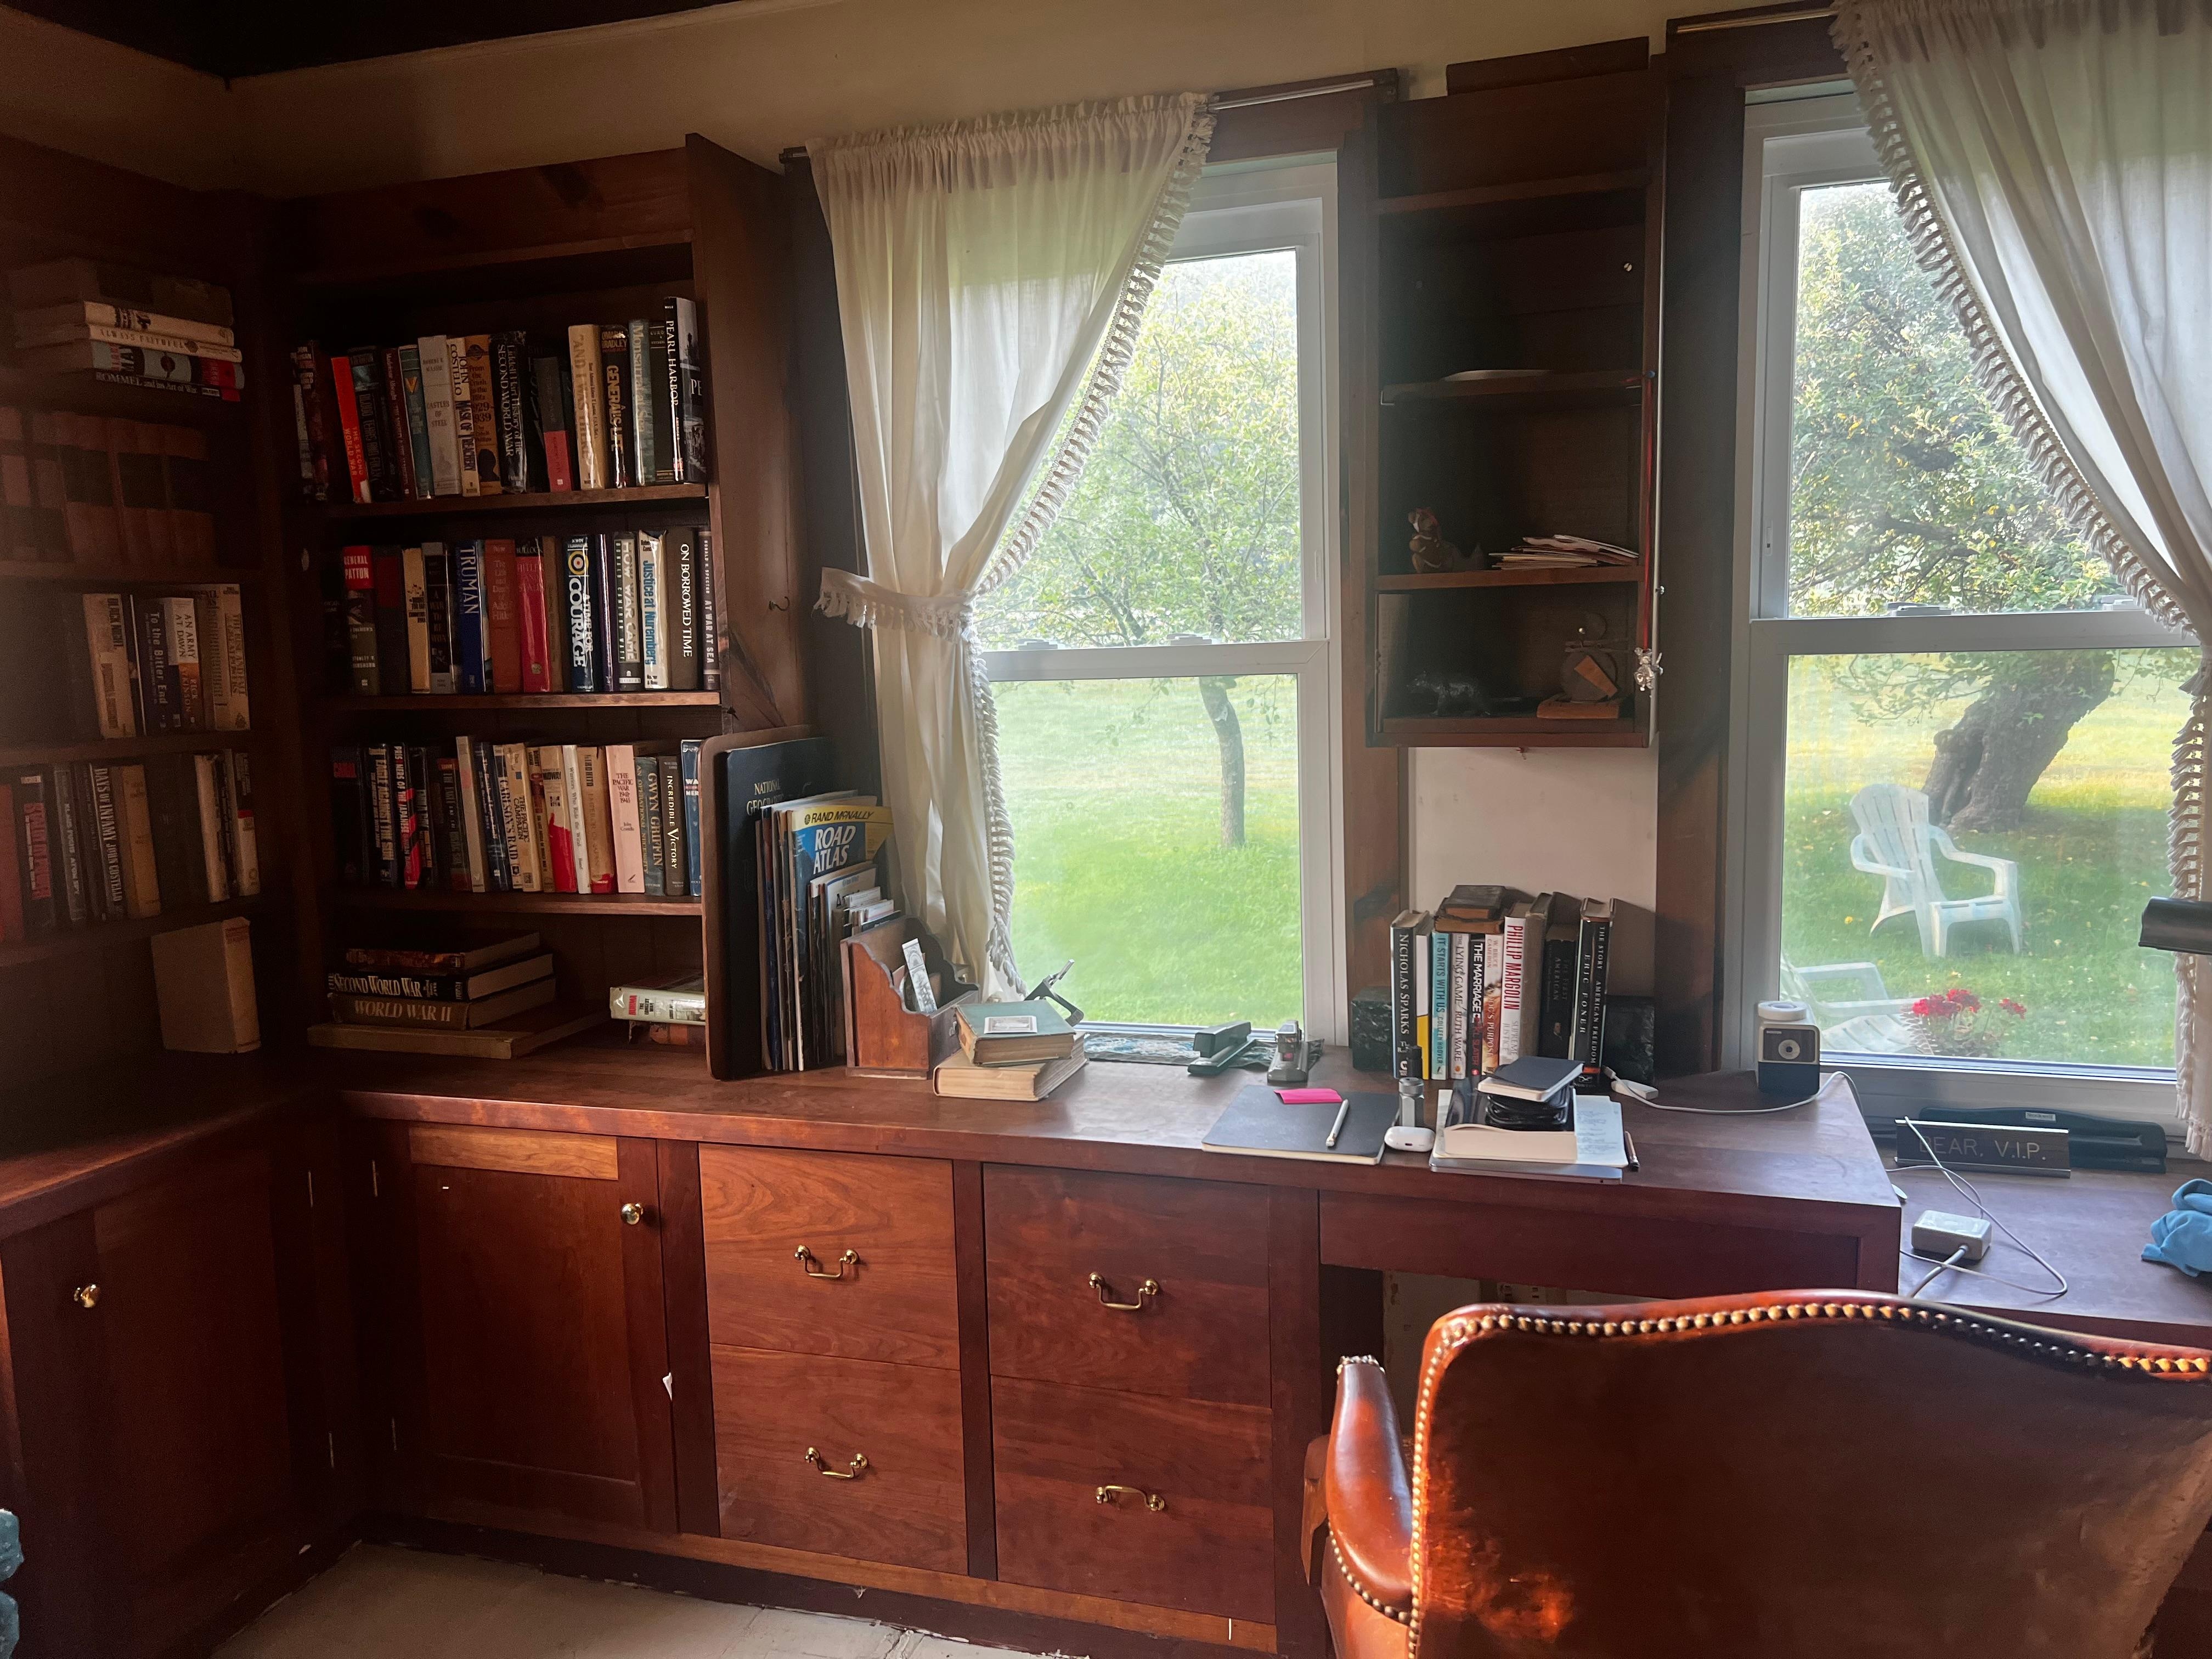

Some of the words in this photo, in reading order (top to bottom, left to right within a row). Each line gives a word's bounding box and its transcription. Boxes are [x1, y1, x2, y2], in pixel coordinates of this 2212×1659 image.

[666, 320, 676, 356] PEARL
[450, 344, 462, 395] COSTELLO
[459, 357, 469, 384] JOHN
[498, 345, 508, 389] SECOND
[668, 358, 679, 407] HARBOR
[501, 390, 511, 431] WORLD
[344, 428, 353, 456] WORLD
[504, 432, 514, 456] WAR
[344, 555, 368, 565] GENERAL
[622, 541, 634, 578] HOW
[681, 544, 690, 561] ON
[345, 567, 369, 579] PATTON
[460, 546, 479, 614] TRUMAN
[643, 560, 655, 591] Justice
[623, 583, 635, 619] WAR
[644, 596, 656, 608] at
[681, 563, 692, 627] BORROWED
[705, 600, 712, 610] AT
[150, 612, 160, 625] To
[175, 614, 183, 627] AT
[184, 614, 192, 628] AN
[569, 578, 587, 667] COURAGE
[705, 613, 713, 631] WAR
[153, 628, 162, 646] the
[177, 630, 187, 658] DAWN
[185, 630, 196, 659] ARMY
[625, 622, 638, 662] CAME
[645, 611, 657, 665] Nuremberg
[682, 628, 693, 658] TIME
[706, 633, 714, 645] AT
[154, 650, 165, 681] Bitter
[157, 684, 168, 705] End
[94, 768, 110, 793] DAYS
[396, 781, 405, 789] OF
[637, 765, 642, 777] AN
[100, 793, 110, 803] OF
[648, 772, 659, 812] GWYN
[667, 775, 676, 826] INCREDIBLE
[754, 778, 781, 795] NATIONAL
[399, 804, 410, 833] JAPANESE
[499, 780, 515, 834] CARLSON'S
[507, 836, 518, 860] RAID
[514, 798, 524, 840] CAMPAIGN
[637, 780, 646, 830] OPERATIONAL
[811, 811, 834, 823] RAND
[99, 804, 117, 842] INFAMY
[521, 813, 530, 843] PACIFIC
[815, 825, 856, 851] ROAD
[106, 843, 119, 864] JOHN
[650, 816, 664, 867] GRIFFIN
[667, 827, 680, 869] VICTORY
[813, 845, 850, 874] ATLAS
[109, 865, 123, 902] COSTELLO
[1473, 943, 1483, 962] THE
[1505, 925, 1523, 960] PHILLIP
[1398, 934, 1409, 990] NICHOLAS
[1436, 947, 1446, 977] STARTS
[1454, 945, 1464, 975] LYING
[1582, 953, 1591, 984] ERIC
[334, 973, 369, 994] SECOND
[368, 975, 401, 996] WORLD
[400, 977, 423, 998] WAR
[1436, 979, 1446, 1000] WITH
[1454, 975, 1464, 1005] GAME
[1472, 963, 1483, 1012] MARRIAGE
[1504, 962, 1522, 1010] MARGOLIN
[354, 1000, 403, 1018] WORLD
[406, 1004, 437, 1022] WAR
[441, 1006, 452, 1023] II
[1399, 992, 1410, 1035] SPARKS
[1436, 1003, 1446, 1013] US
[1486, 997, 1495, 1019] DOG'S
[1579, 992, 1590, 1034] FONER
[1593, 980, 1602, 1023] AMERICAN
[1454, 1011, 1463, 1036] RUTH
[1502, 1023, 1510, 1052] JUSTICE
[1511, 1020, 1520, 1055] SUPREME
[1454, 1037, 1463, 1062] WARE
[1486, 1022, 1495, 1057] PURPOSE
[1590, 1025, 1600, 1064] FREEDOM
[1918, 1136, 1984, 1158] BEAR,
[1994, 1140, 2046, 1160] V.I.P.
